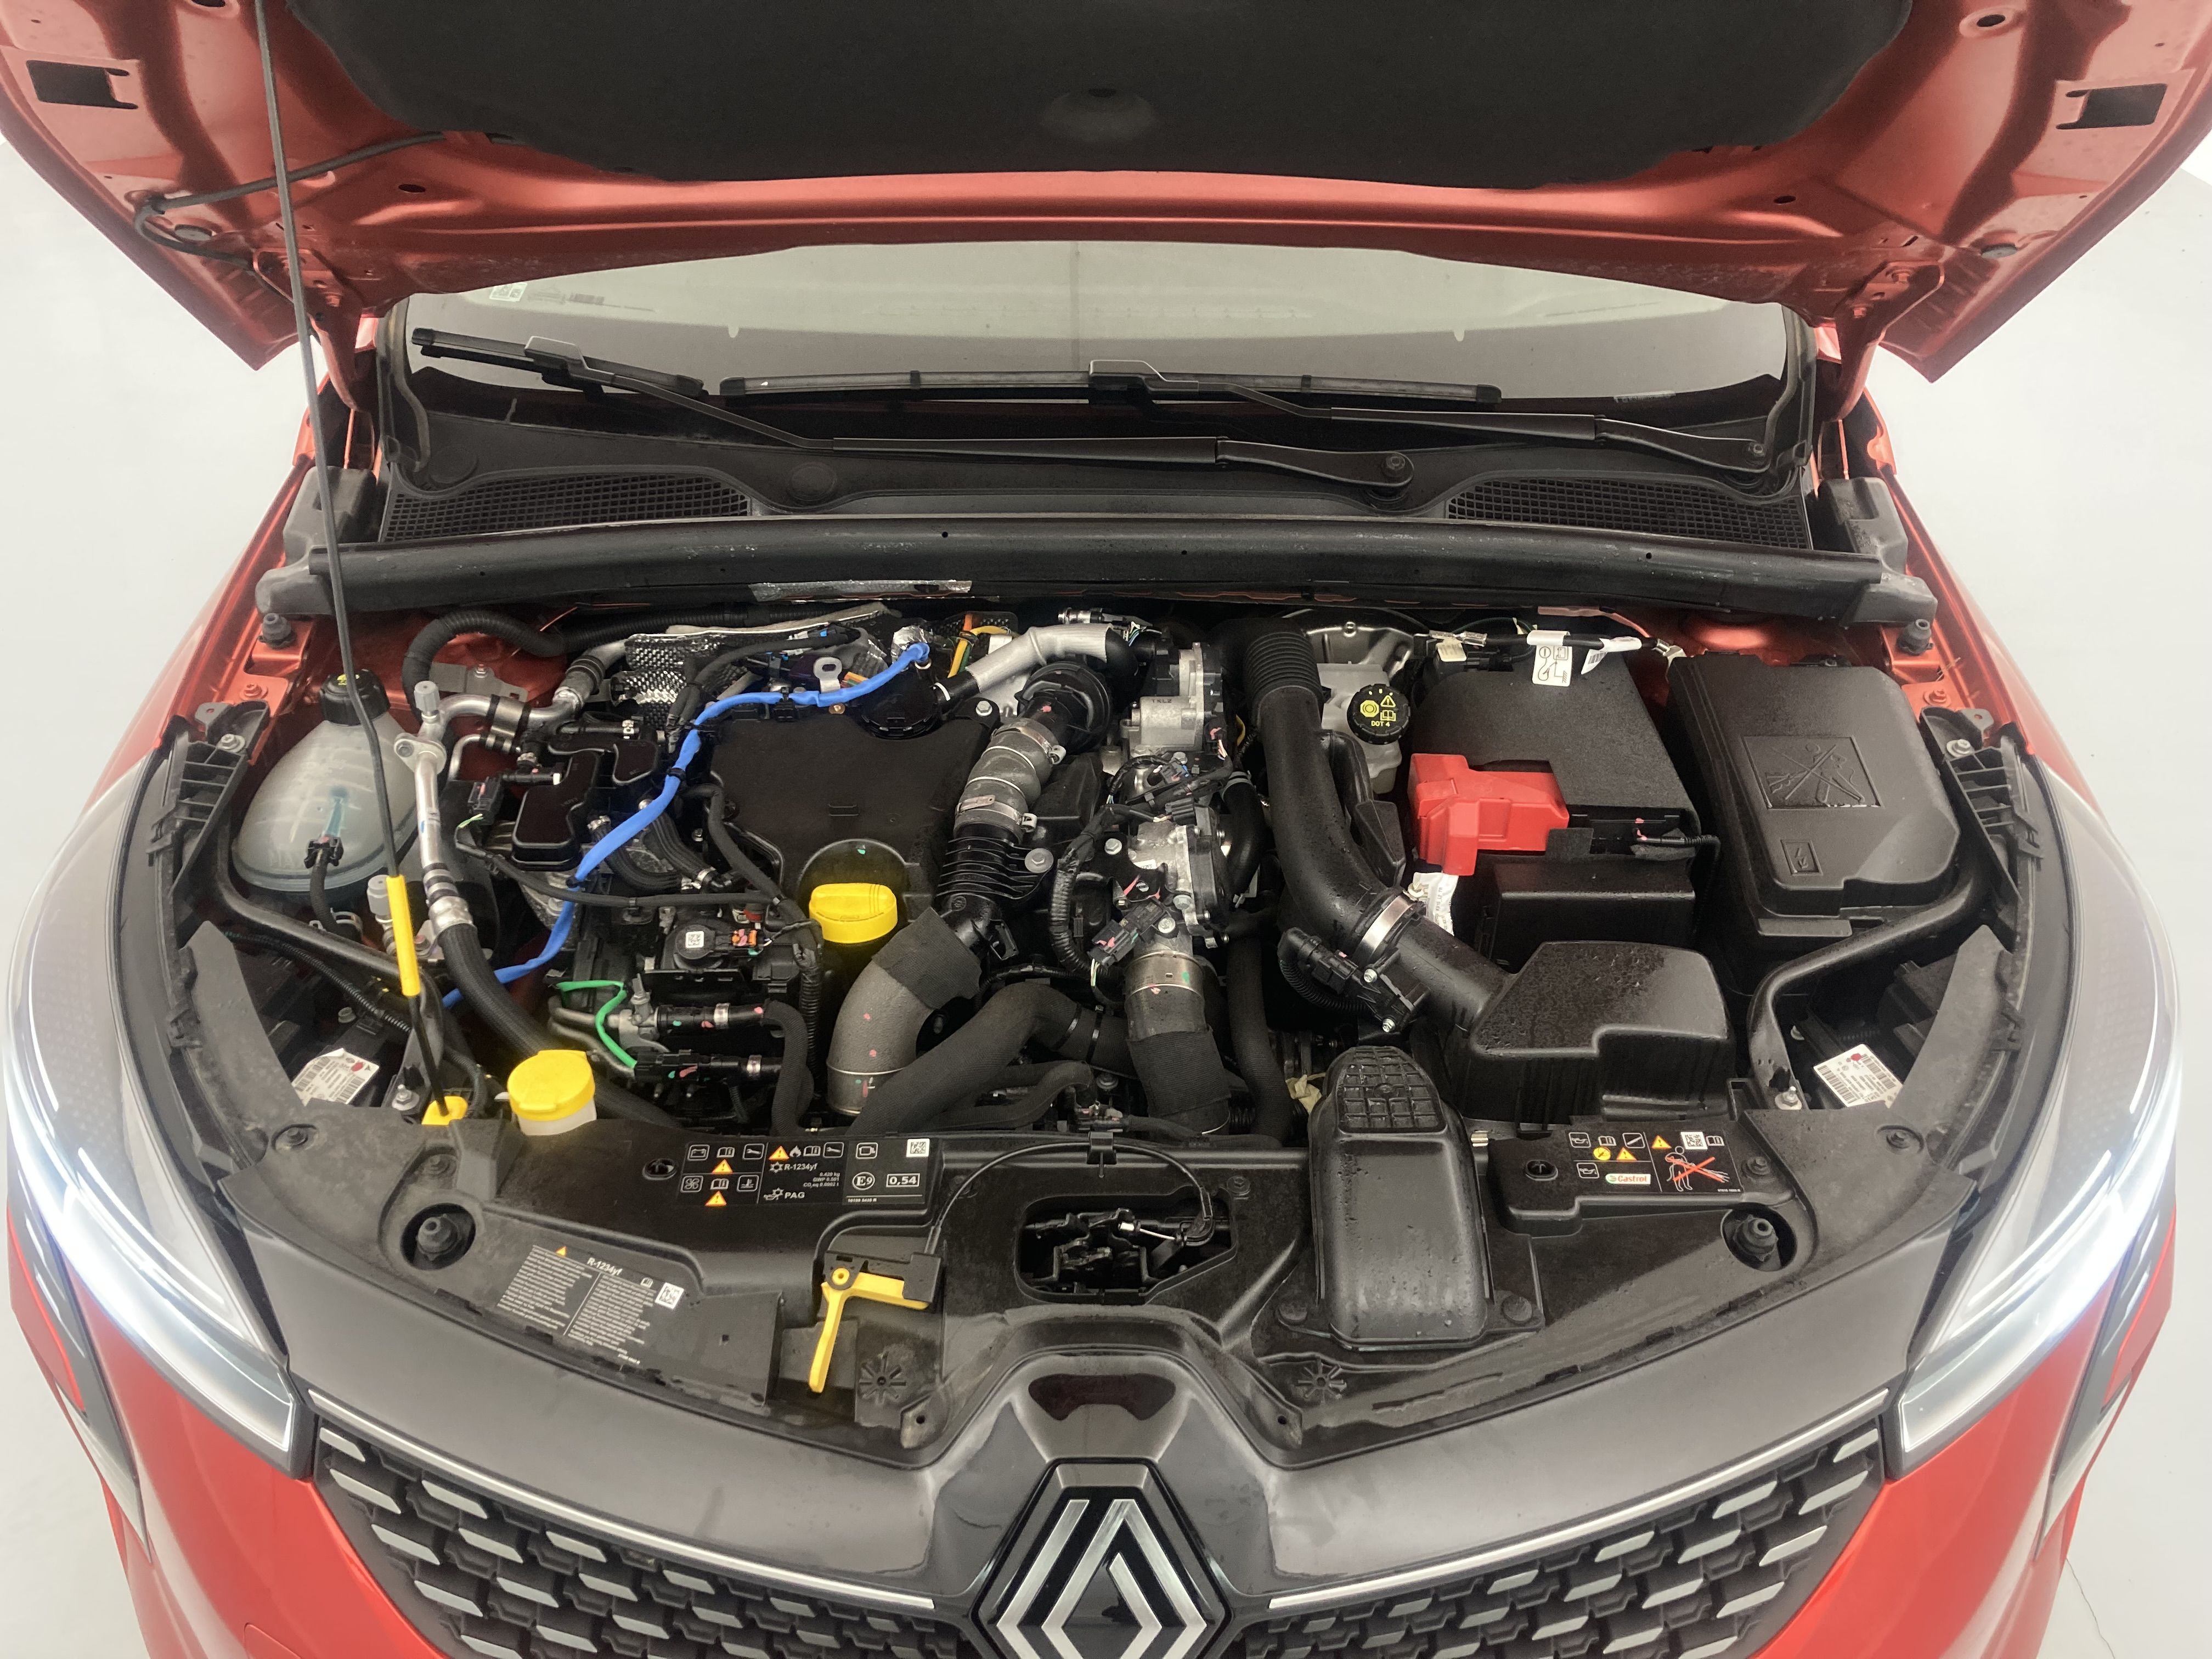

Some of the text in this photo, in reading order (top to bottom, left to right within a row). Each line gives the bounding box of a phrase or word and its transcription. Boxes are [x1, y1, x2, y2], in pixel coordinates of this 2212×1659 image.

[784, 1163, 818, 1172] R-1234yf
[856, 1176, 873, 1187] E9
[889, 1176, 917, 1186] 0,54
